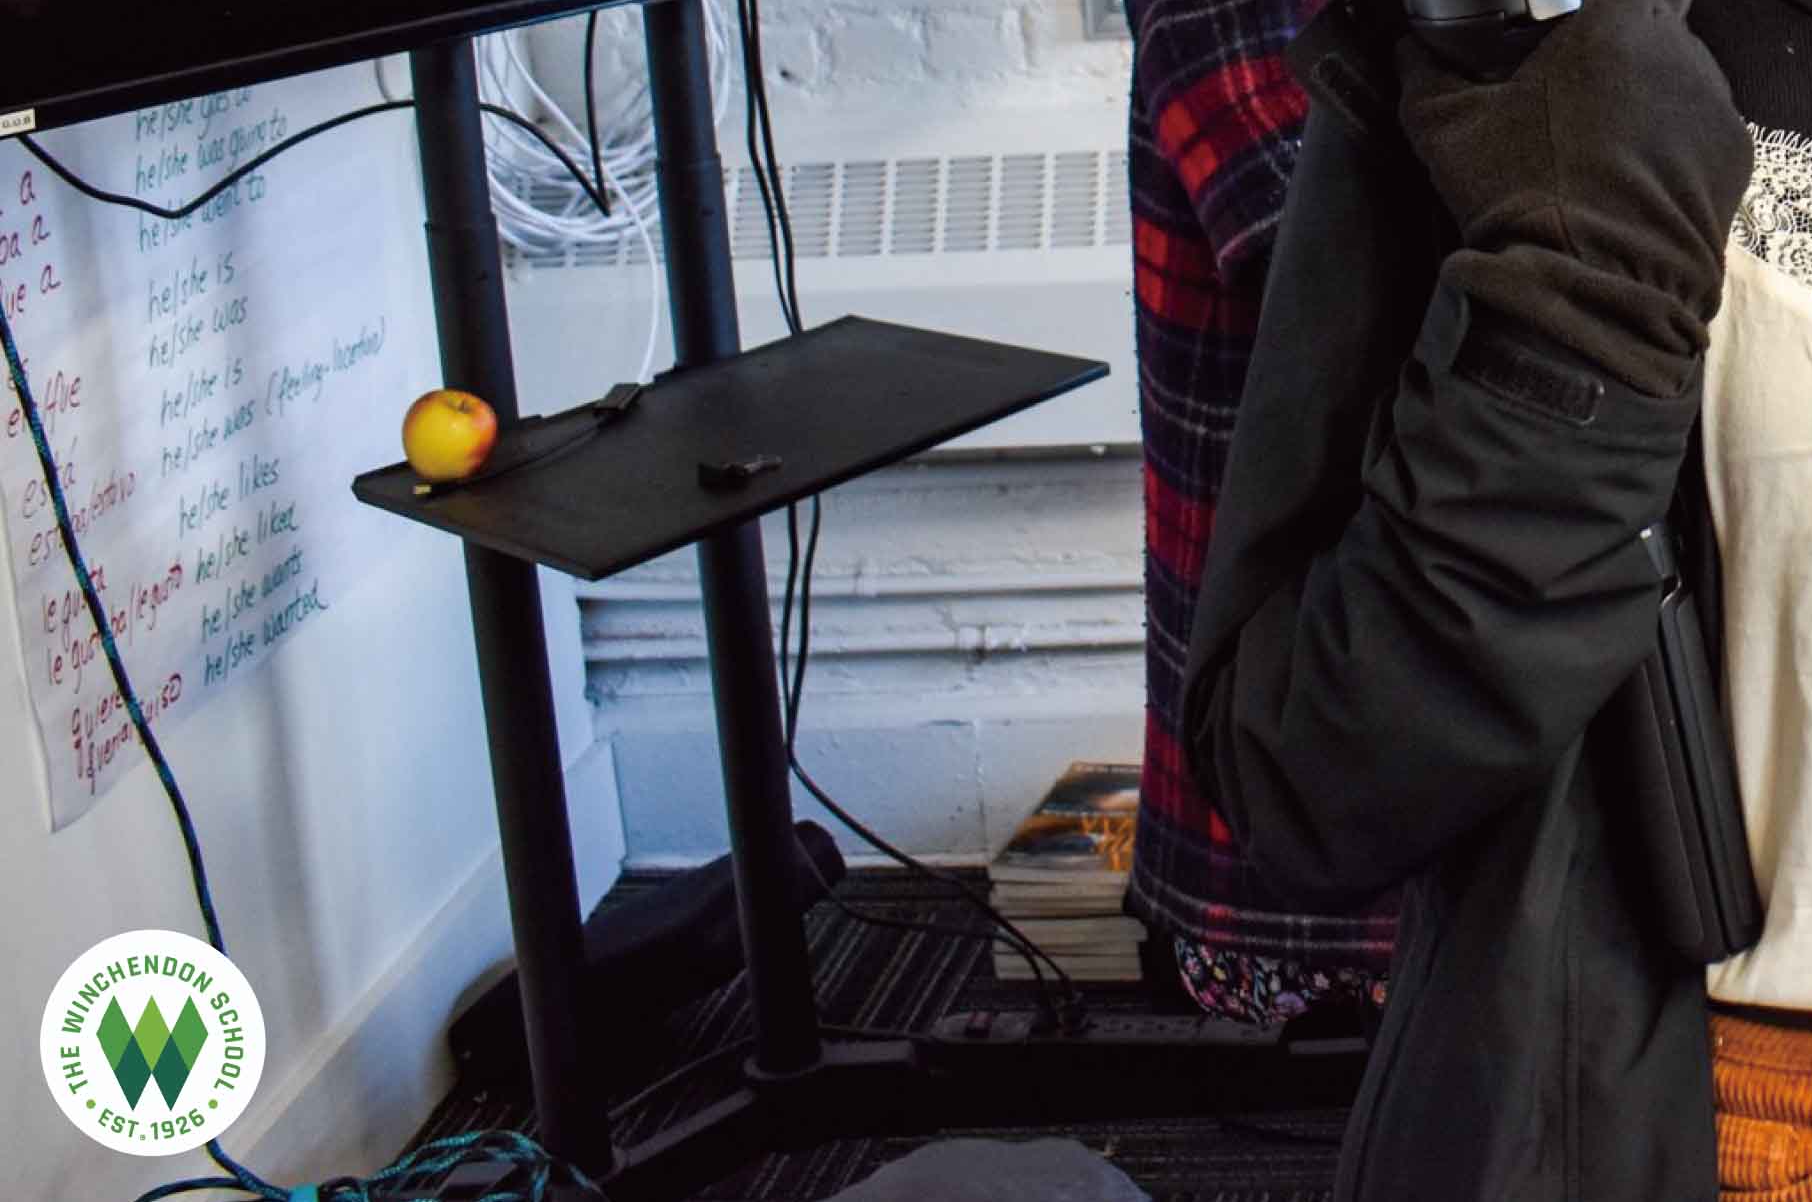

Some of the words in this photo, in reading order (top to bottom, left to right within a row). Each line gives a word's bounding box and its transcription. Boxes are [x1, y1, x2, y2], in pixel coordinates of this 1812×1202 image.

[149, 264, 207, 324] he/she
[216, 251, 235, 283] is
[195, 525, 250, 584] he/she
[200, 585, 258, 643] he/she
[204, 630, 256, 687] he/she
